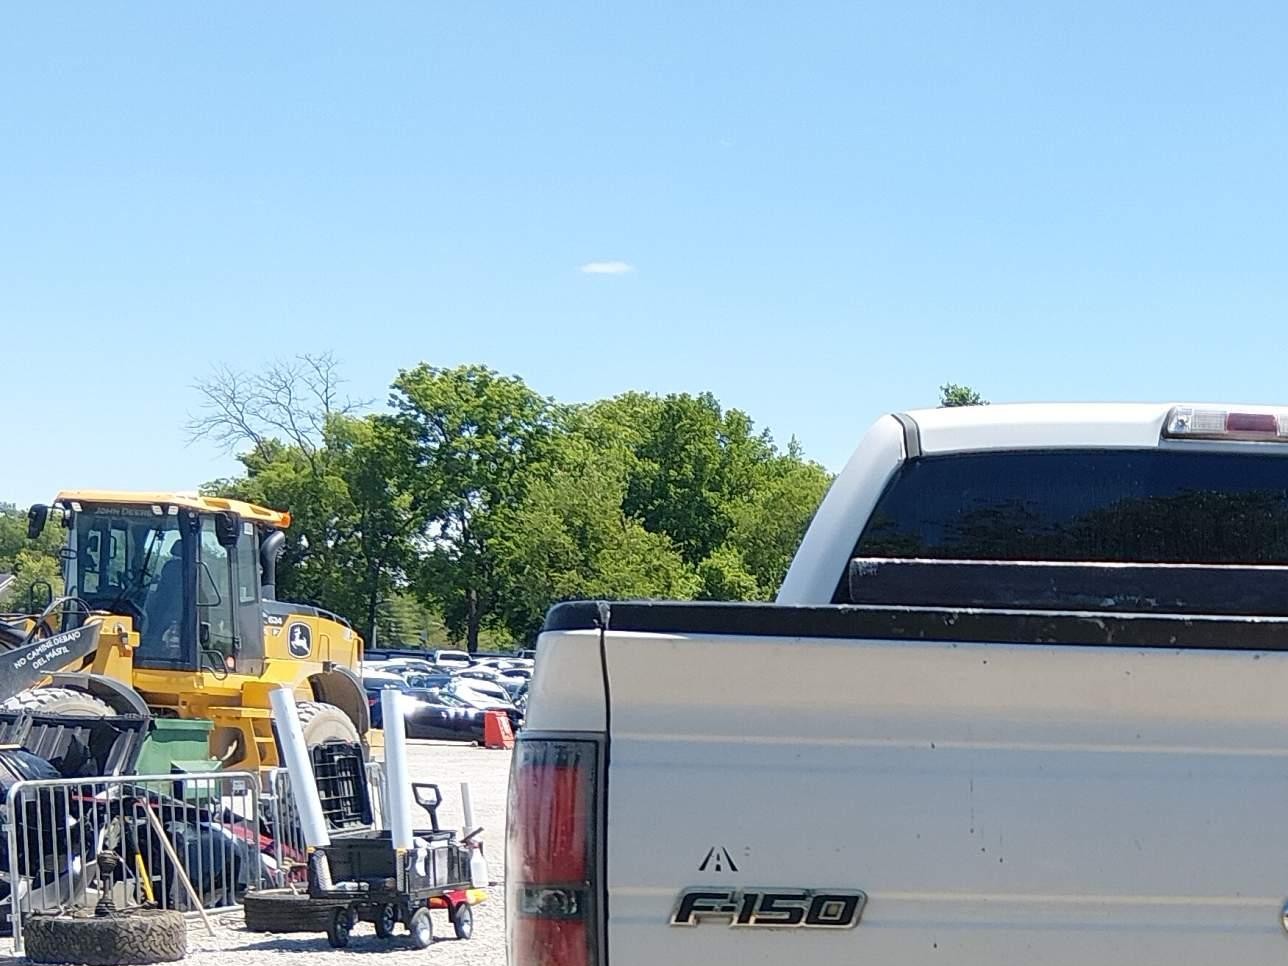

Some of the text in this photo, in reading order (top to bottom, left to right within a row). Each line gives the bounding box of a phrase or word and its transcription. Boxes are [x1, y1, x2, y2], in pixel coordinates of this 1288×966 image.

[95, 507, 120, 516] JOHN
[13, 631, 81, 669] NO CAMINE DEBAJO
[32, 658, 47, 669] DEL
[669, 887, 867, 929] F-150
